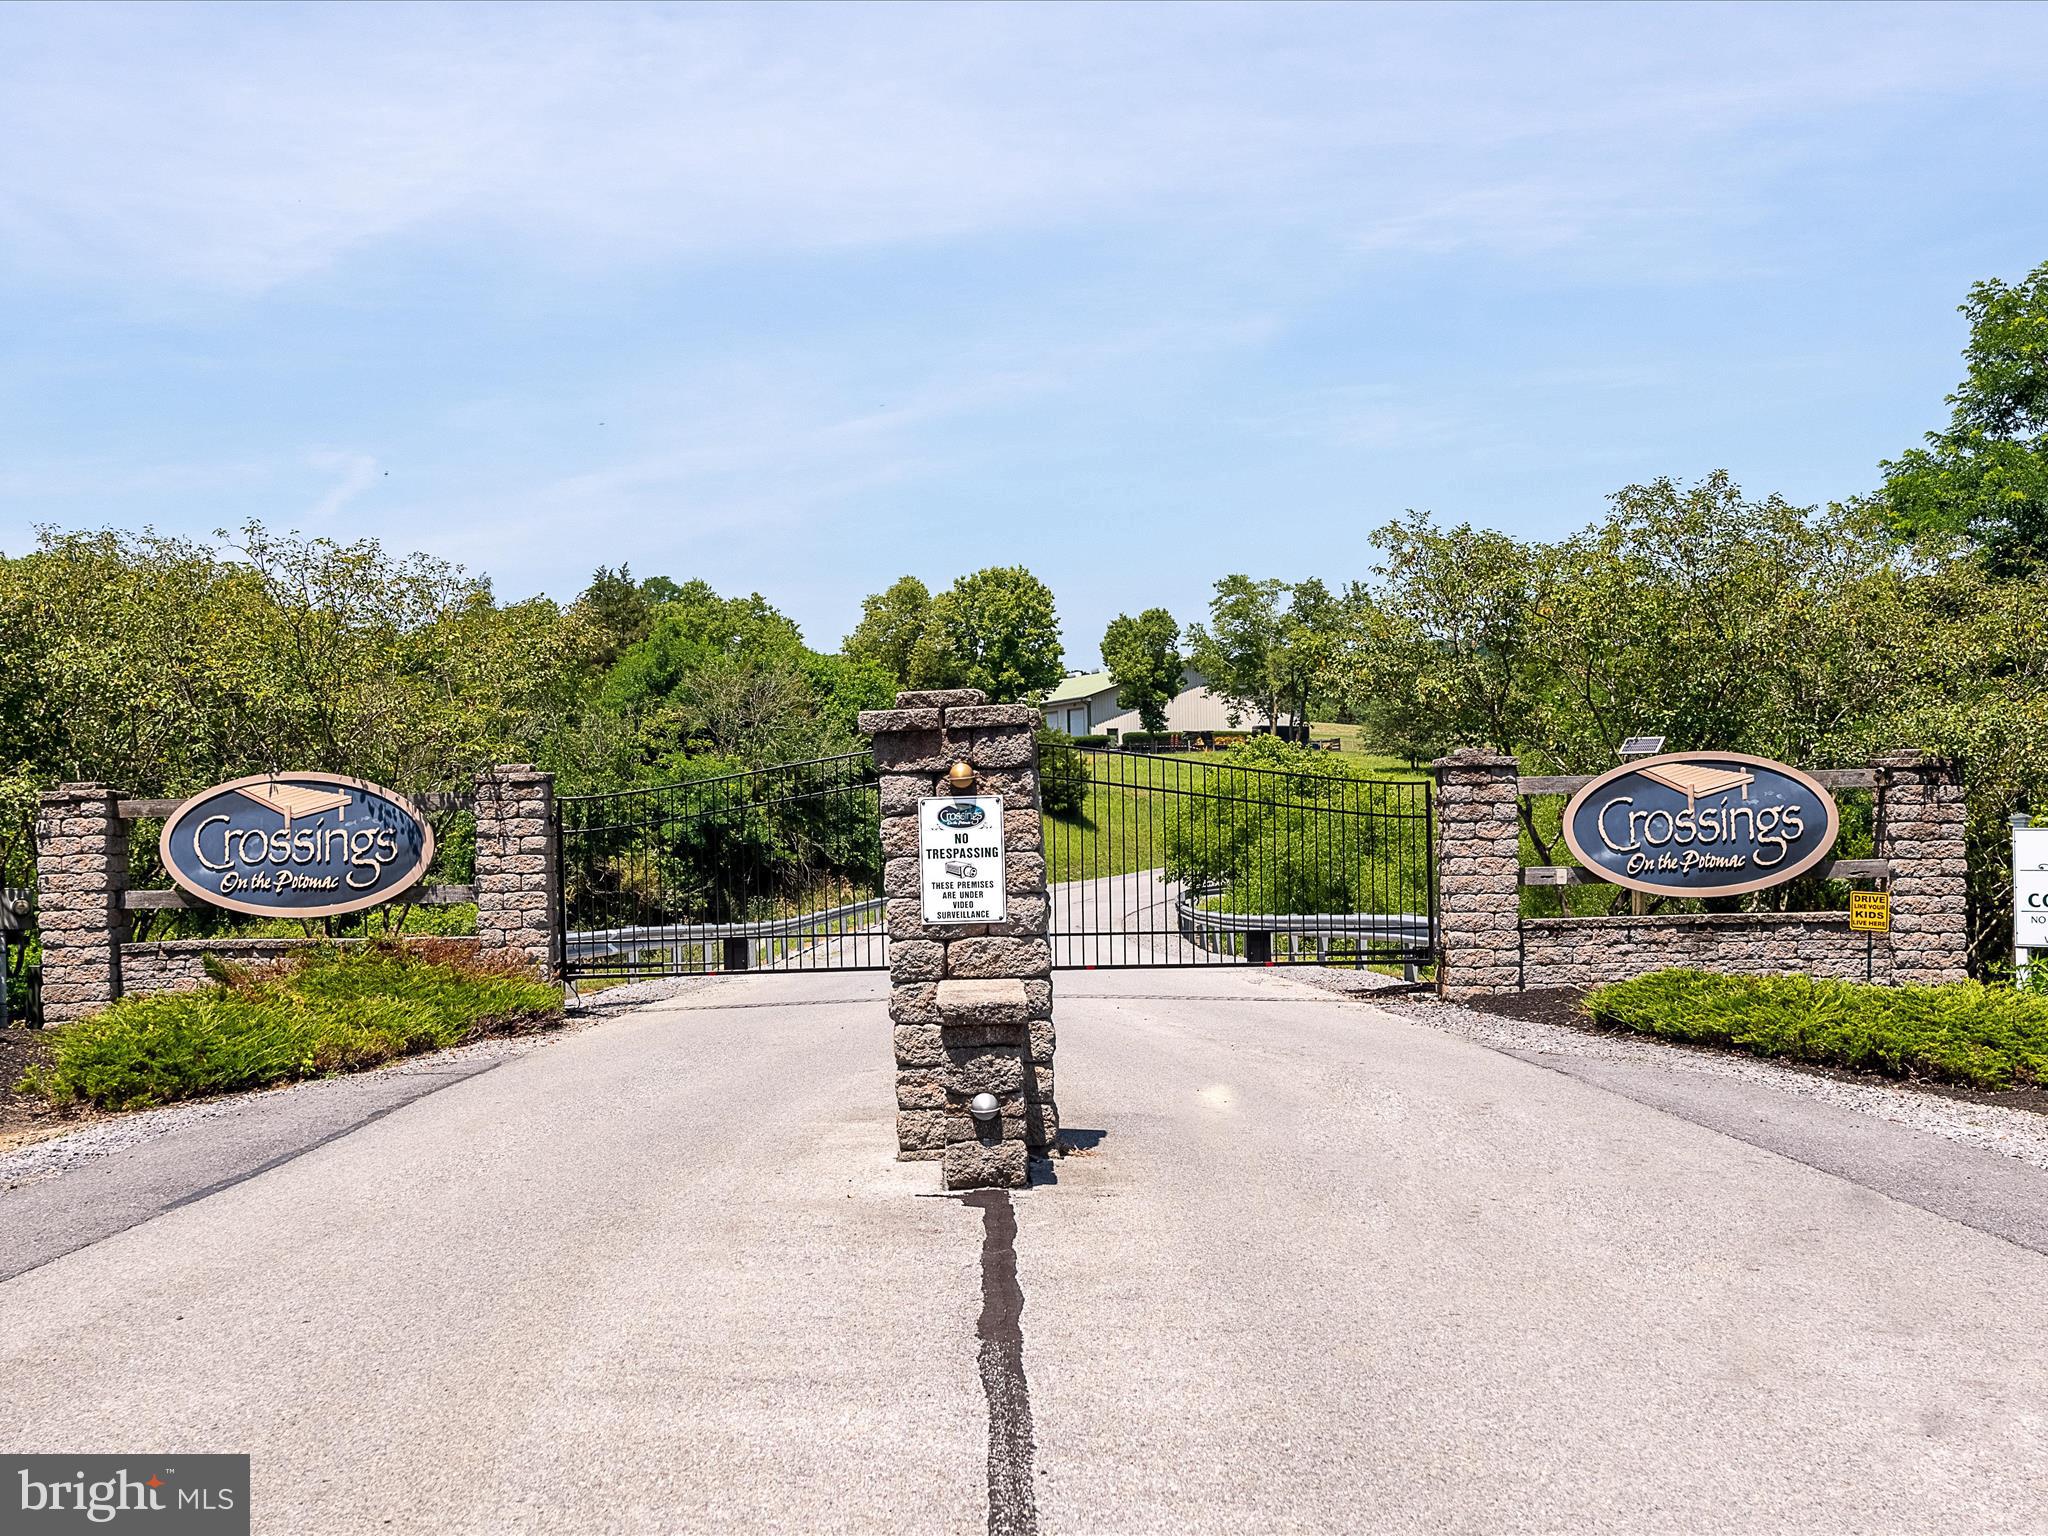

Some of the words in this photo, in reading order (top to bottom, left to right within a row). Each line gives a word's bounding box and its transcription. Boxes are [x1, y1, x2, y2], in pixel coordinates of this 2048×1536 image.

[940, 809, 983, 825] Crossings
[1598, 797, 1804, 866] Crossings
[954, 833, 969, 844] NO
[193, 815, 399, 888] Crossings
[926, 847, 999, 859] TRESPASSING
[1627, 852, 1654, 875] On
[1657, 851, 1679, 870] the
[1680, 850, 1746, 873] Potomac
[220, 871, 248, 894] On
[251, 871, 272, 890] the
[273, 869, 339, 894] Potomac
[931, 881, 954, 890] THESE
[957, 880, 994, 889] PREMISES
[942, 891, 957, 899] ARE
[959, 891, 984, 899] UNDER
[1854, 895, 1885, 903] DRIVE
[953, 901, 974, 909] VIDEO
[937, 910, 990, 919] SURVEILLANCE
[1855, 911, 1884, 919] KIDS
[2031, 916, 2046, 924] NO
